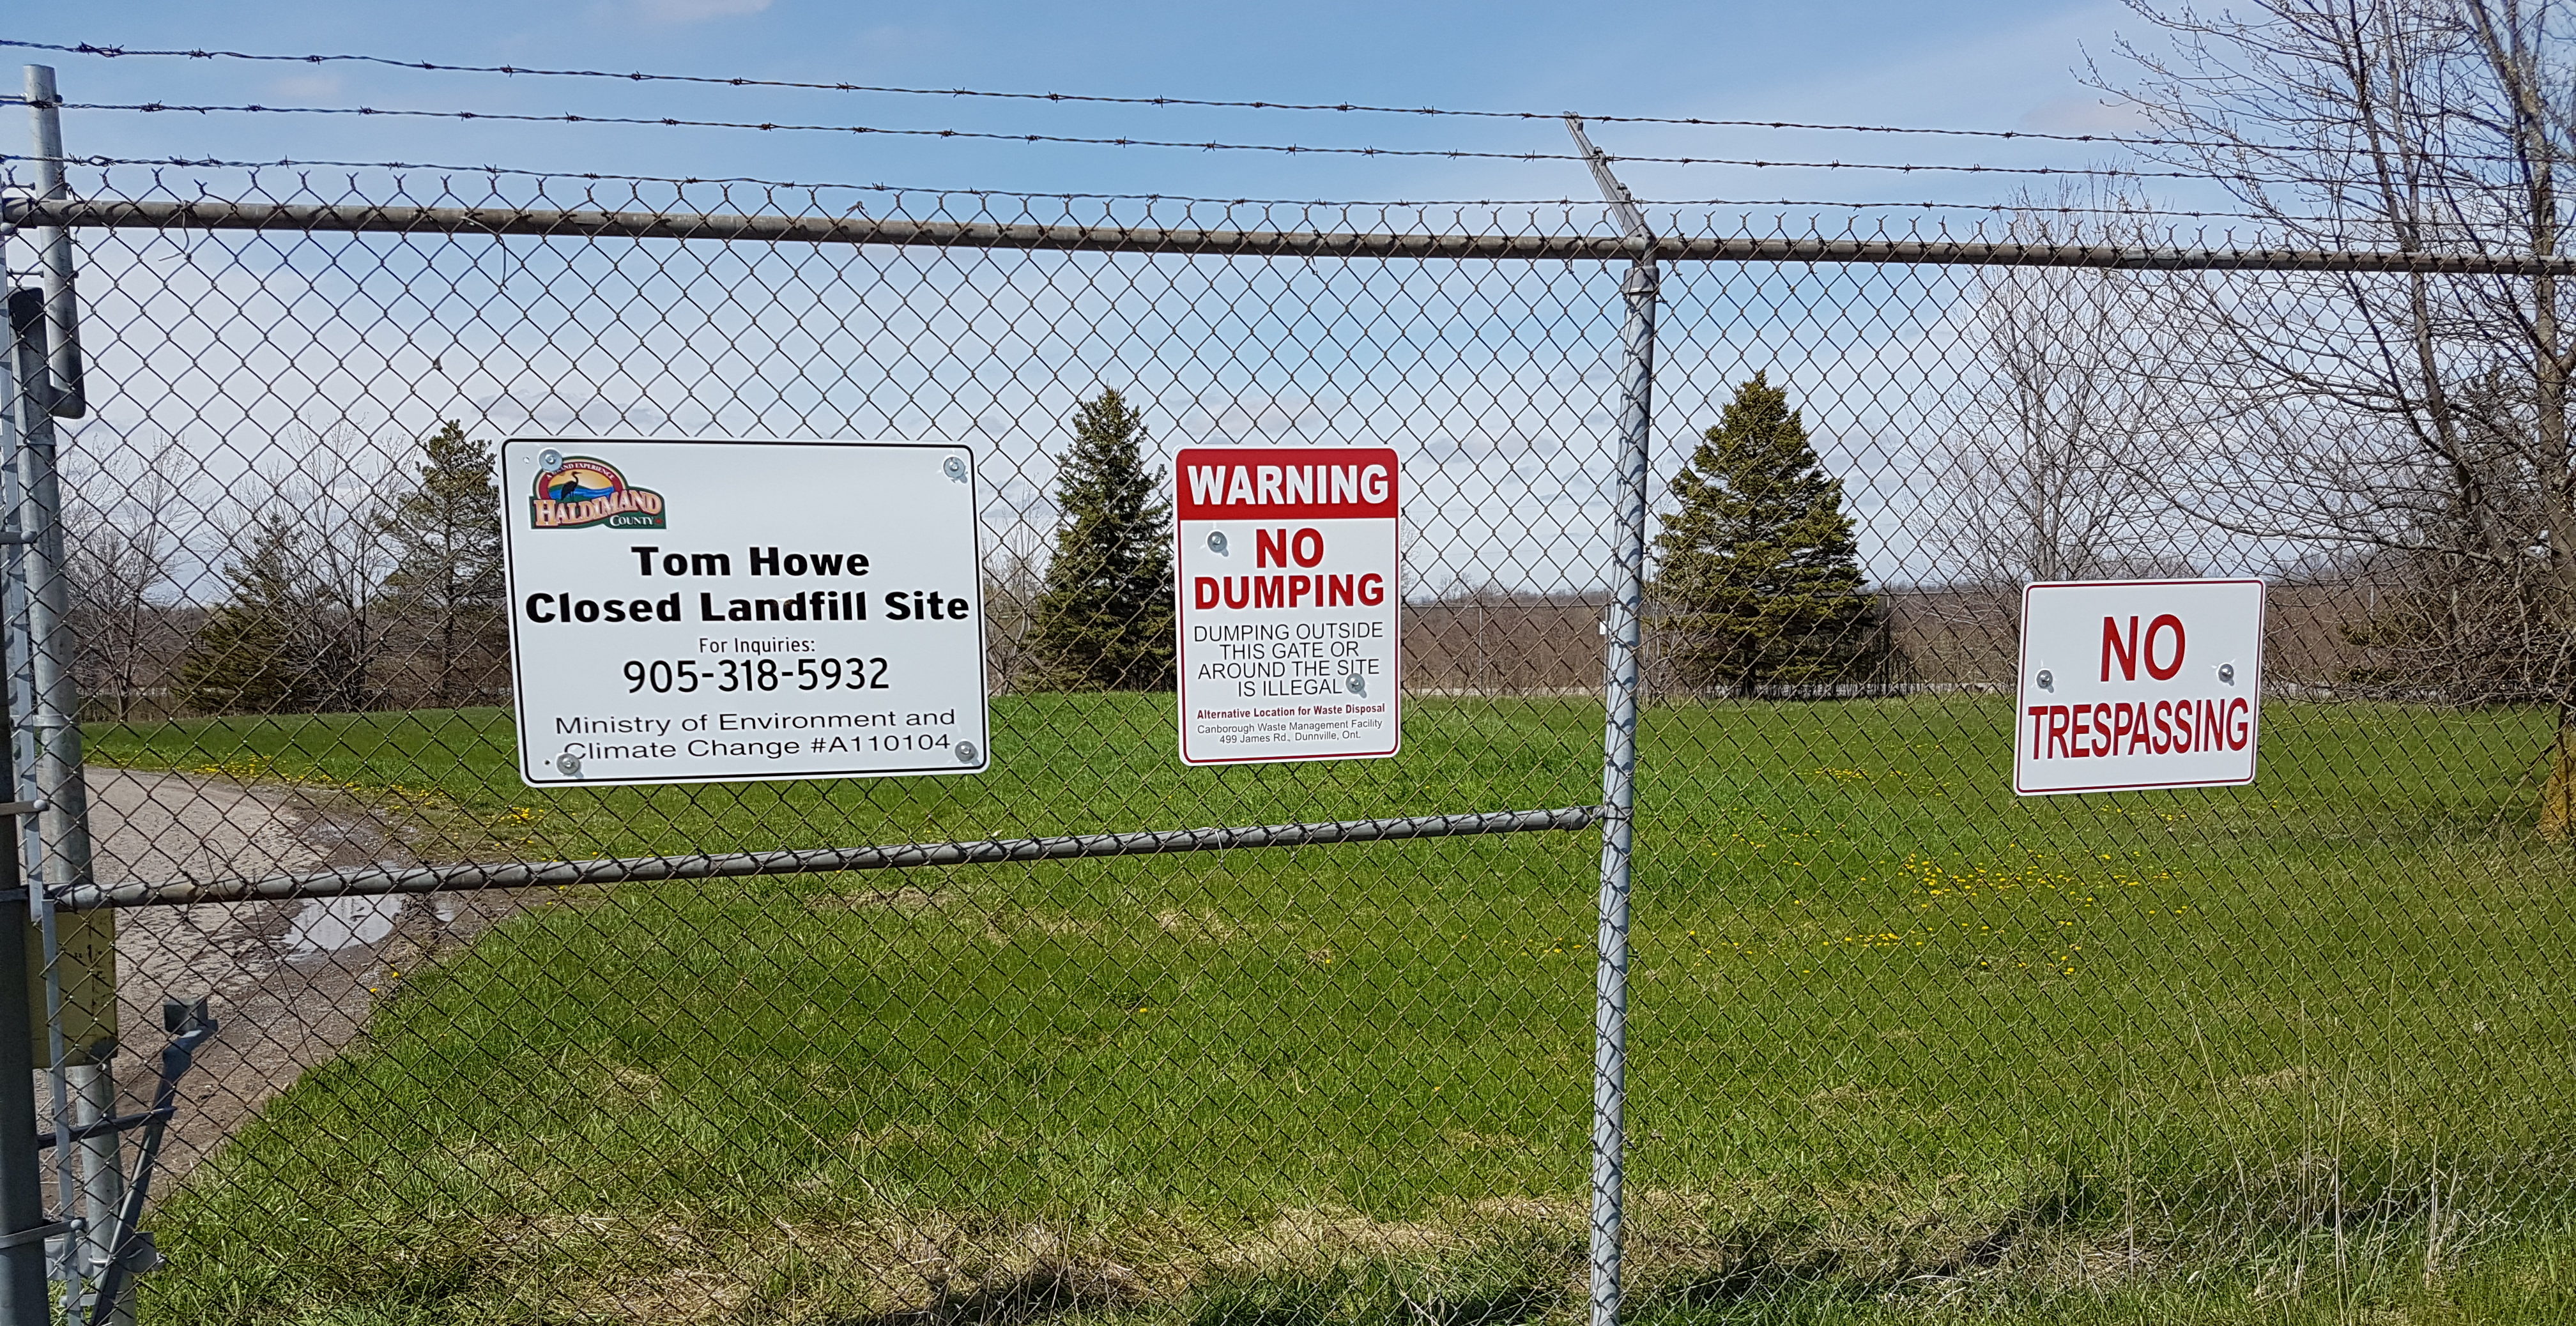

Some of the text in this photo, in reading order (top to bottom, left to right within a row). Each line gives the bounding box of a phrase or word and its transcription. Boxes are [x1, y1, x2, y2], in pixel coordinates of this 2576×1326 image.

[575, 463, 615, 480] EXPERIENCE
[1187, 464, 1388, 505] WARNING
[534, 490, 662, 526] HALDIMAND
[610, 515, 654, 526] COUNTY
[1257, 528, 1323, 568] NO
[631, 547, 869, 575] Tom Howe
[1195, 574, 1383, 609] DUMPING
[526, 591, 969, 623] Closed Landfill Site
[1195, 622, 1383, 641] DUMPING OUTSIDE
[700, 637, 815, 655] For Inquiries:
[1220, 641, 1358, 660] THIS GATE OR
[2101, 614, 2185, 682] NO
[624, 658, 889, 693] 905-318-5932
[1198, 659, 1379, 679] AROUND THE SITE
[1239, 679, 1342, 697] IS ILLEGAL
[556, 709, 954, 736] Ministry of Environment and
[1197, 703, 1384, 719] Alternative Location for Waste Disposal
[1198, 724, 1254, 734] Canborough
[1290, 720, 1349, 732] Management
[1352, 719, 1382, 729] Facility
[1220, 735, 1237, 743] 499
[1240, 733, 1270, 743] James
[1296, 731, 1338, 741] Dunnville,
[2028, 697, 2248, 759] TRESPASSING
[564, 734, 950, 759] Climate Change #A110104
